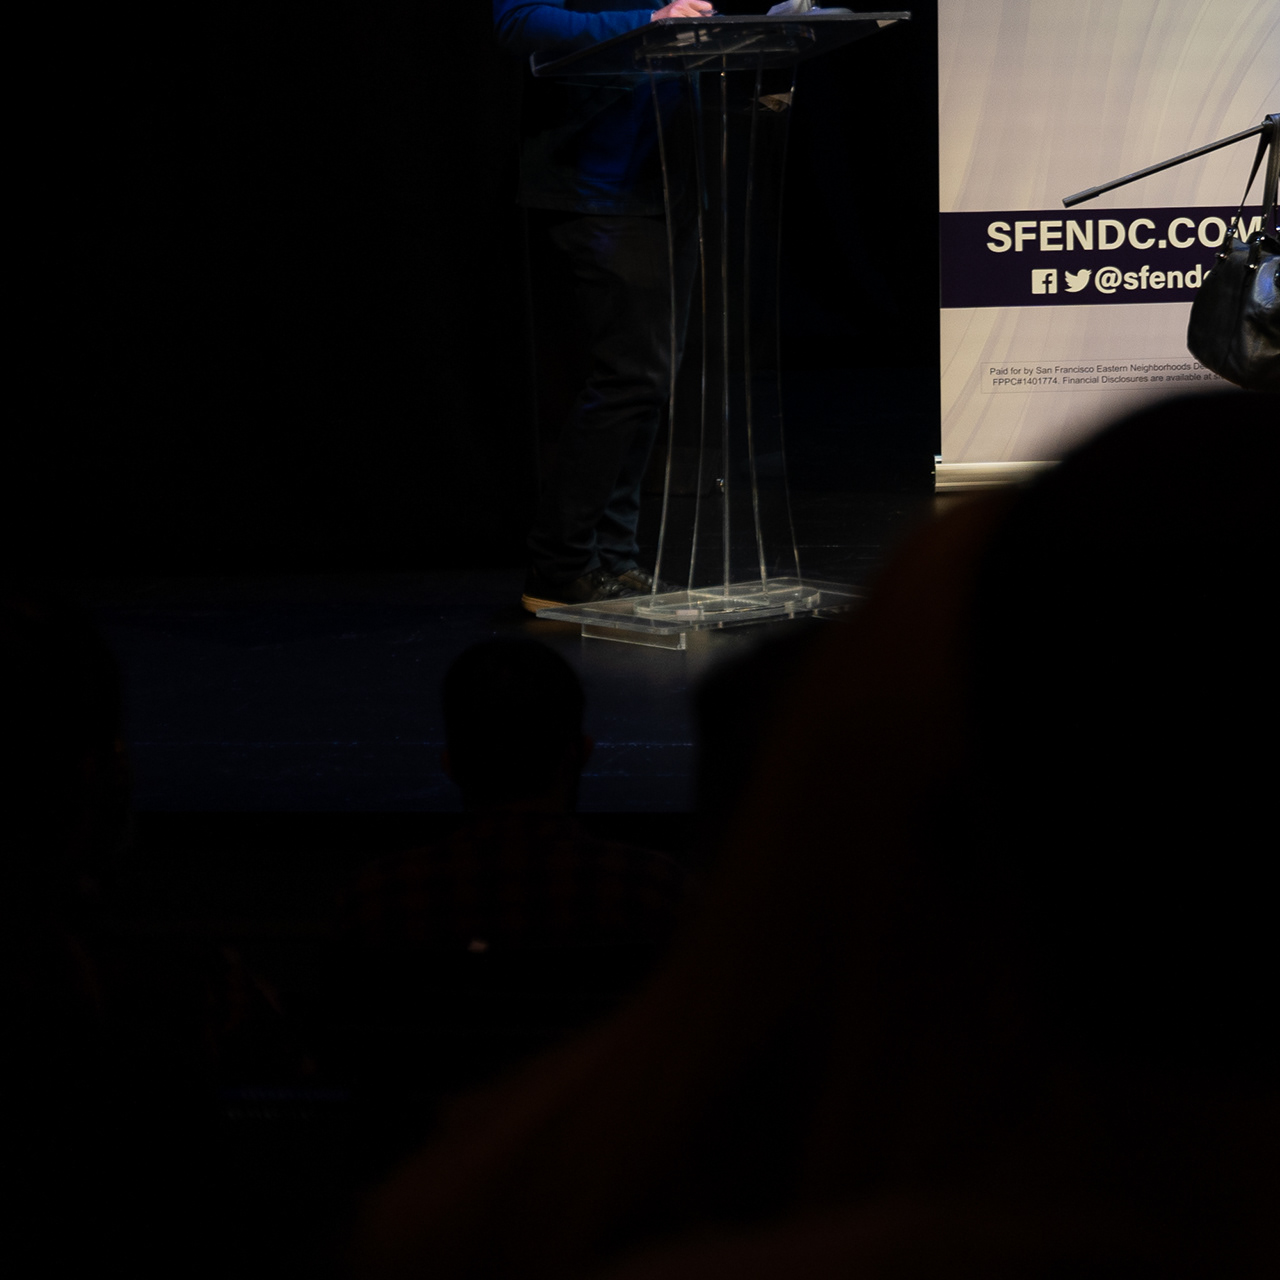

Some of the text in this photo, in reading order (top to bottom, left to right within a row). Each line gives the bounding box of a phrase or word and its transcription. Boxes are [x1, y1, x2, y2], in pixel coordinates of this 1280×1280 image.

[1094, 264, 1212, 294] @sfend
[989, 367, 1009, 376] Paid
[1010, 366, 1021, 375] for
[1023, 366, 1034, 376] by
[1035, 366, 1053, 375] San
[1054, 365, 1095, 374] Francisco
[1096, 364, 1128, 373] Eastern
[1130, 363, 1192, 373] Neighborhoods
[1062, 376, 1099, 385] Financial
[1101, 375, 1149, 384] Disclosures
[1165, 373, 1202, 382] available
[1203, 373, 1212, 381] at
